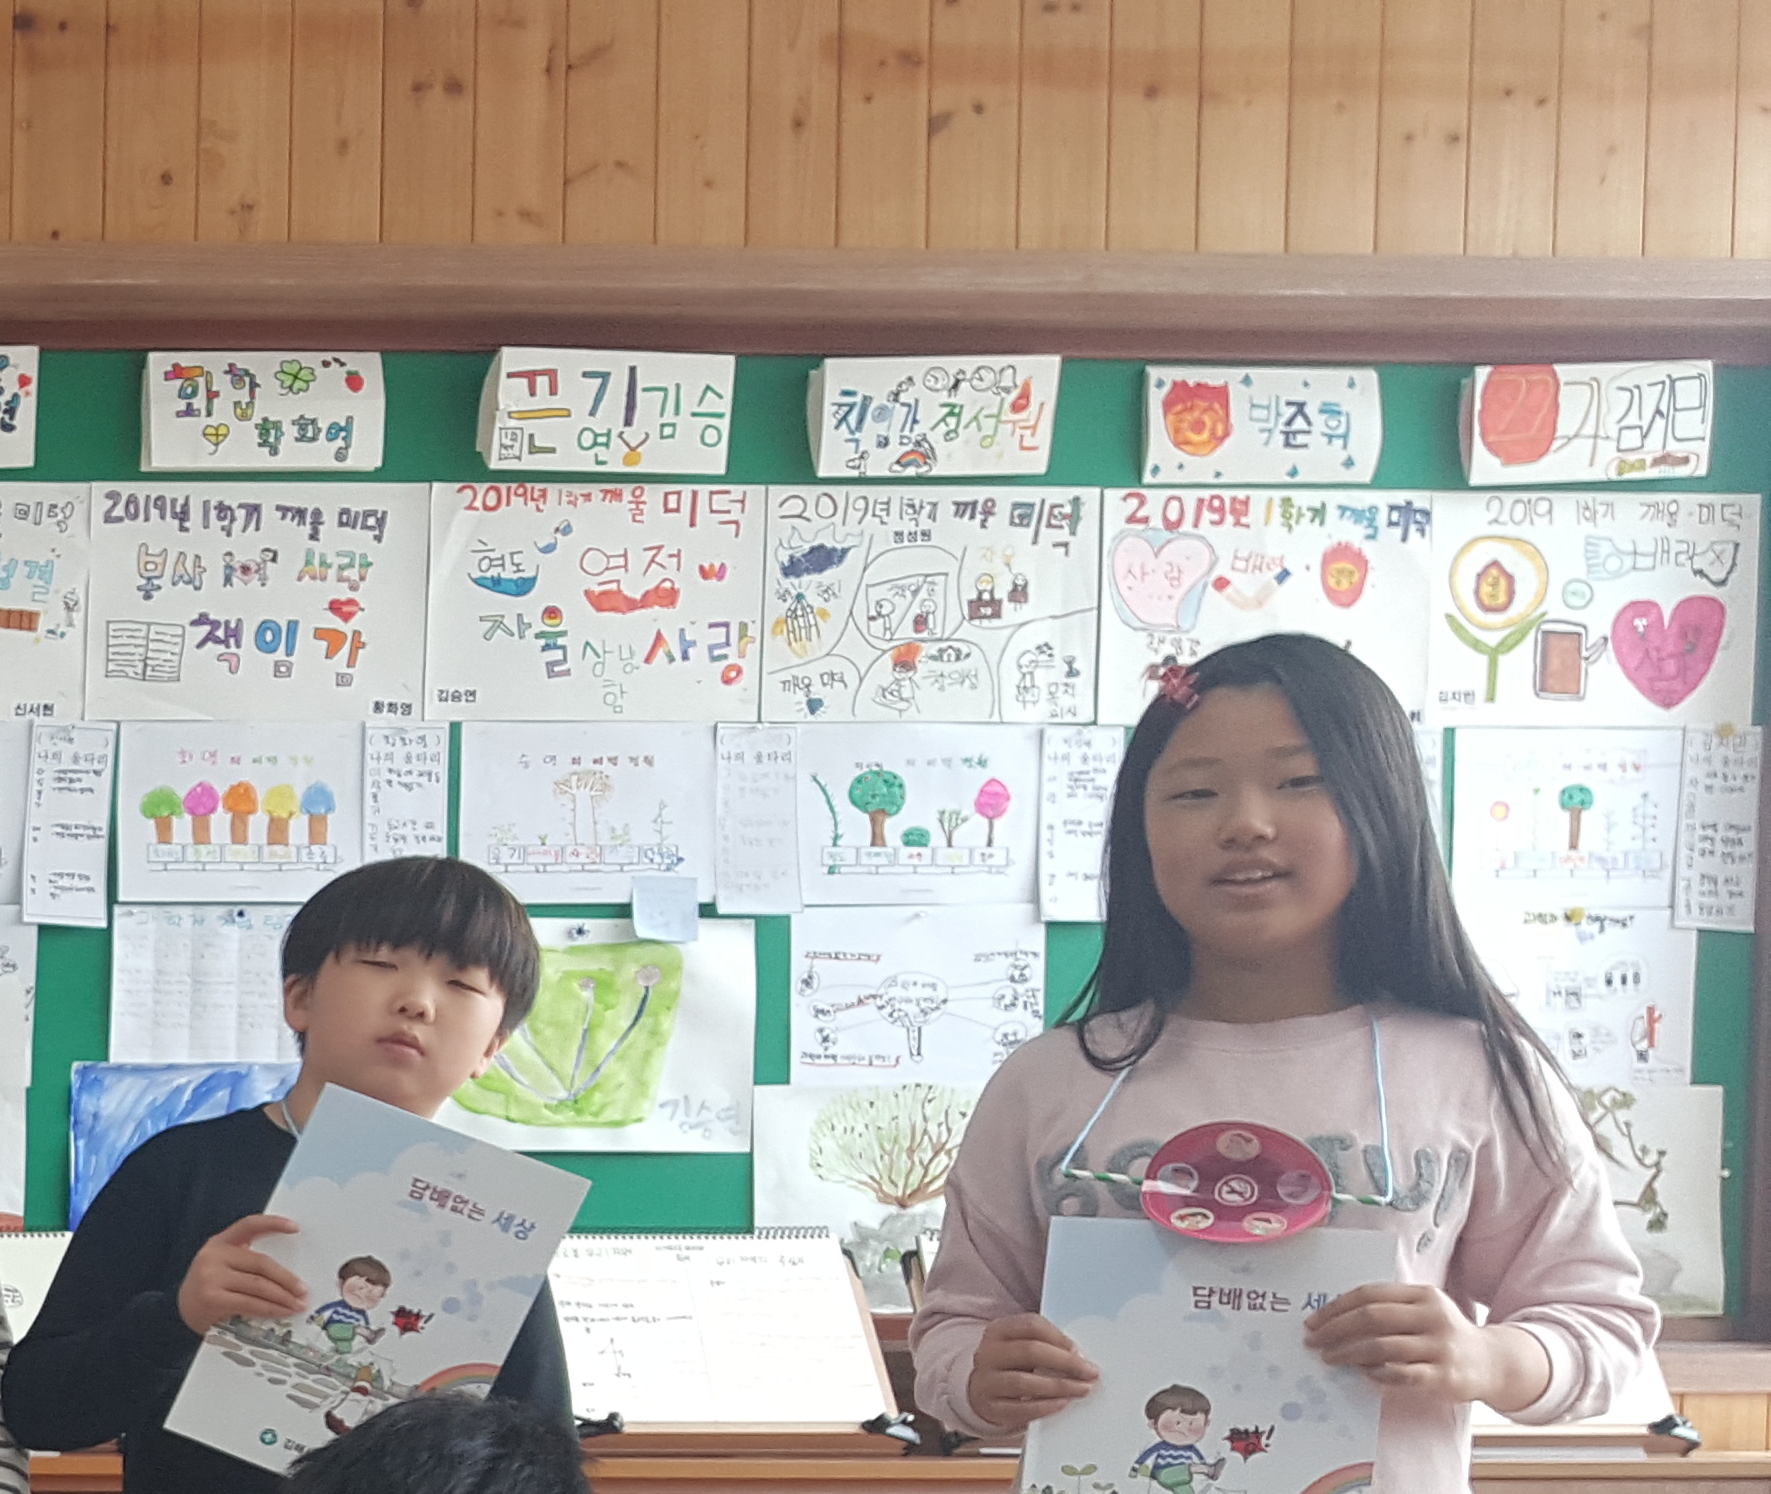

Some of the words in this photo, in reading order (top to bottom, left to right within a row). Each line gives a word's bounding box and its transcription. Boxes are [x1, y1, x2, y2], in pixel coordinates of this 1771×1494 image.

[409, 1177, 485, 1222] 담배없는
[492, 1210, 537, 1241] 세상
[1191, 1285, 1292, 1313] 담배없는
[1301, 1289, 1338, 1313] 세
